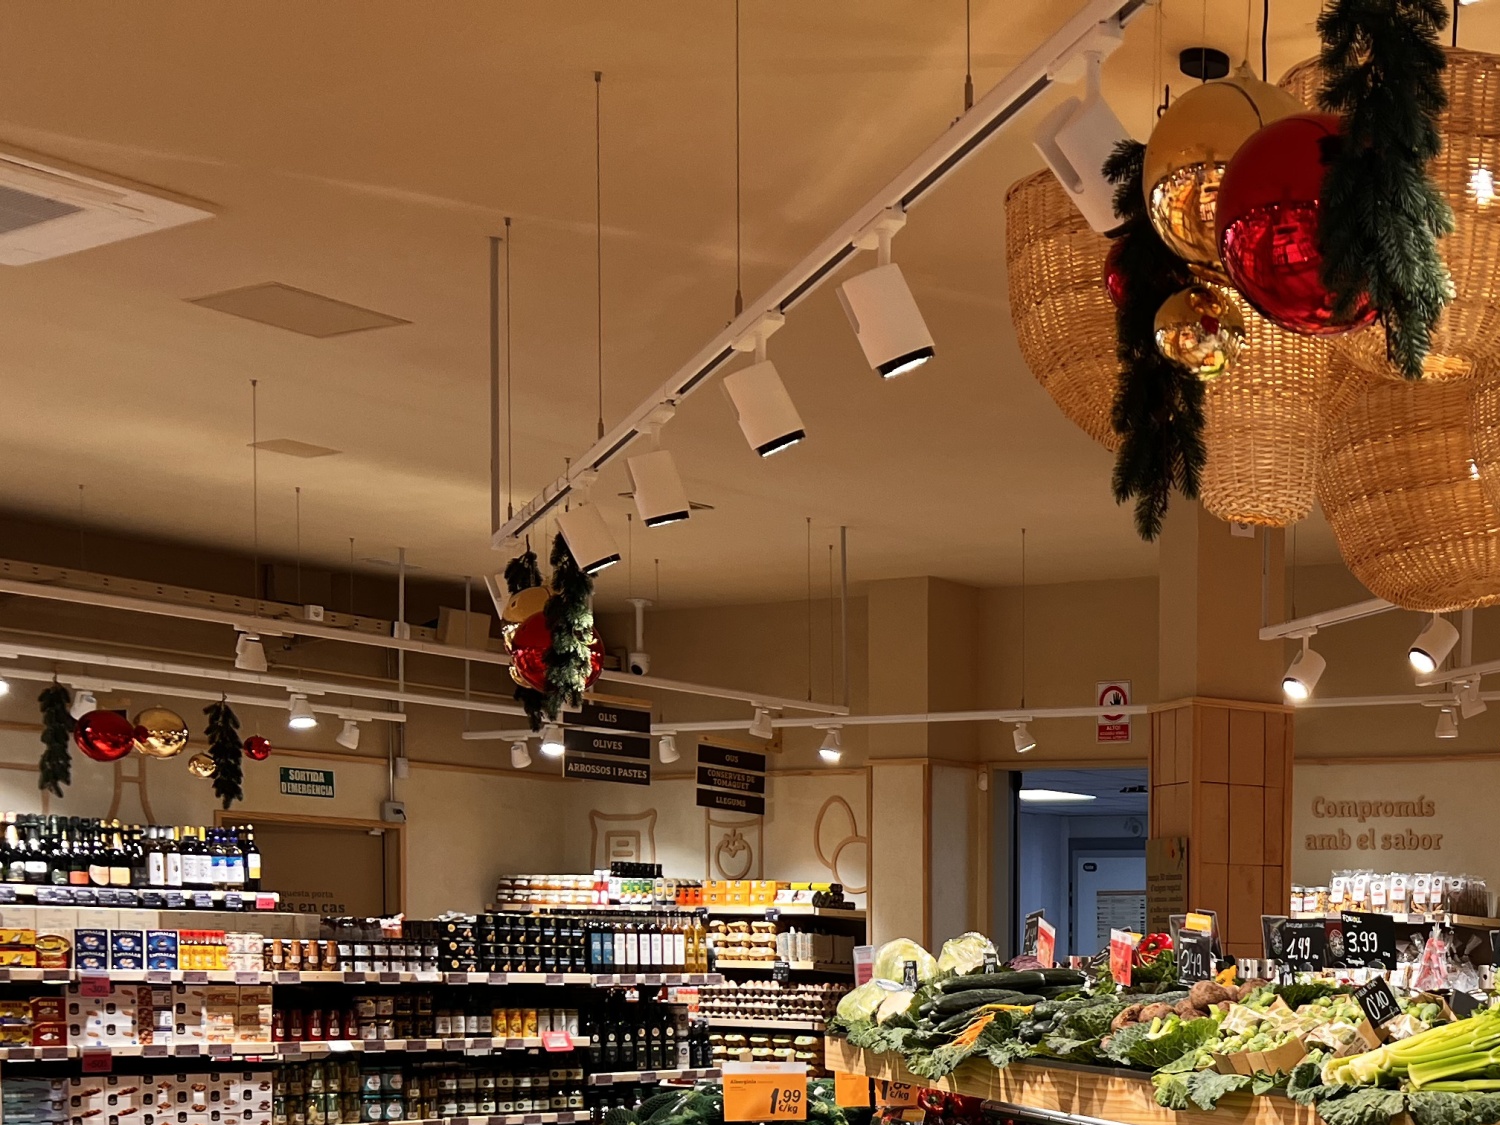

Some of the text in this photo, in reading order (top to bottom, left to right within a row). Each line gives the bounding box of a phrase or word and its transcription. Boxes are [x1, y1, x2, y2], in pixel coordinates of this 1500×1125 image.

[598, 712, 618, 723] OLIS
[593, 739, 623, 751] OLIVES
[725, 754, 739, 764] OUS
[288, 769, 325, 783] SORTIDA
[567, 762, 611, 775] ARROSSOS
[617, 768, 647, 779] PASTES
[707, 769, 745, 783] CONSERVES
[1312, 795, 1435, 823] Compromís
[1305, 828, 1444, 850] amb el sabor
[280, 890, 333, 900] questa porta
[298, 903, 318, 914] en
[321, 903, 346, 914] cas
[770, 1088, 801, 1115] 1,99
[778, 1103, 798, 1114] €/kg
